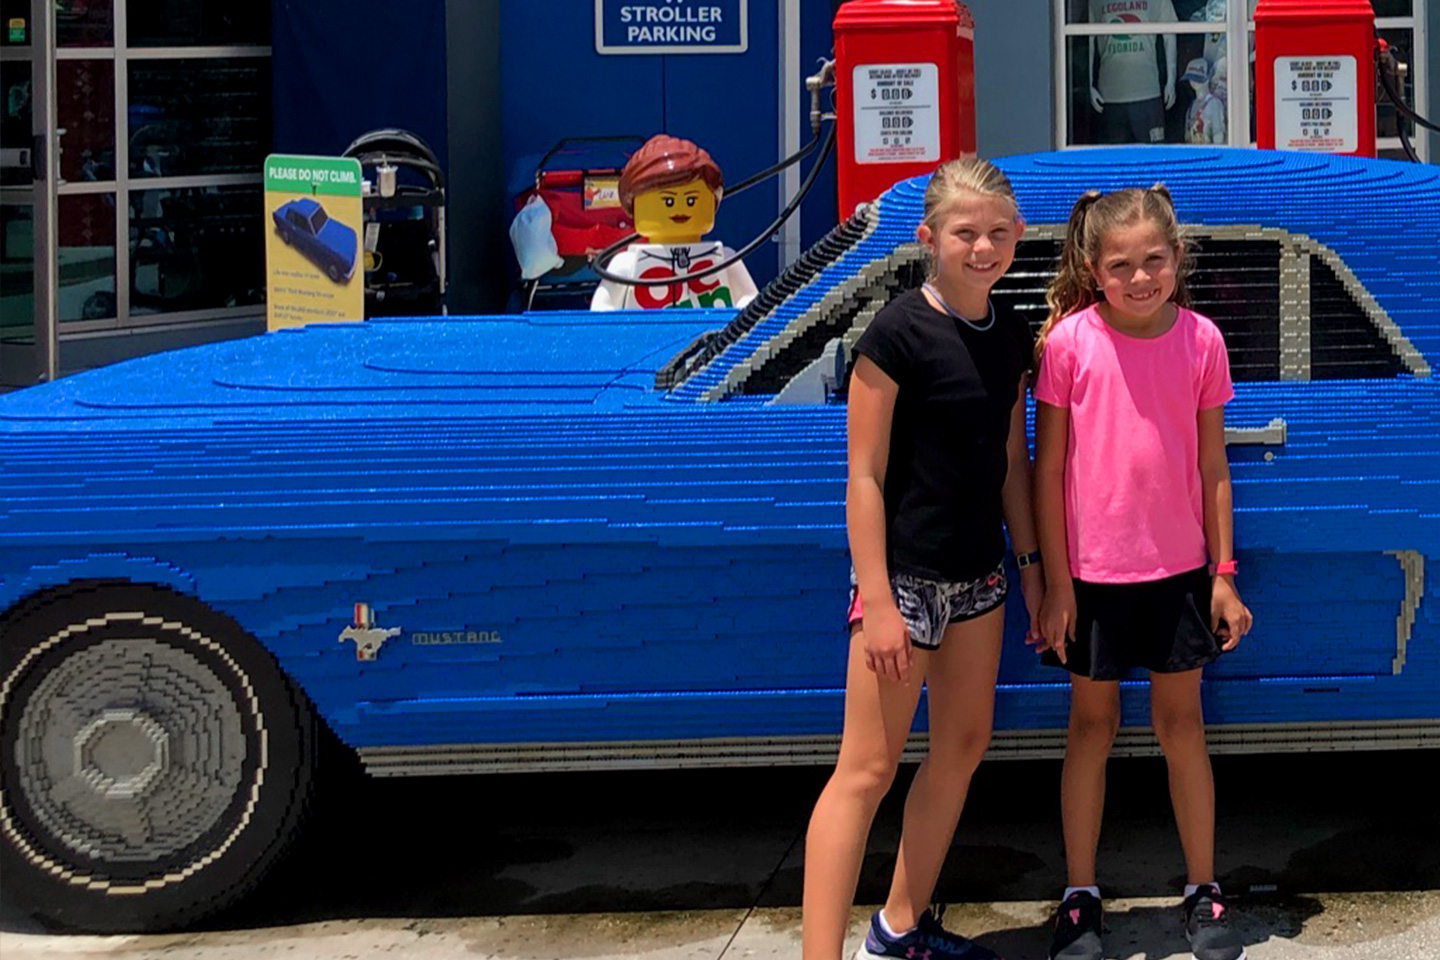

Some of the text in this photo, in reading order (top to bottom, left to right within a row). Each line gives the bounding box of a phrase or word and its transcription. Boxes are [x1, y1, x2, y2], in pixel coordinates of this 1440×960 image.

[619, 5, 723, 23] STROLLER
[1101, 0, 1148, 14] LEGOLAND
[627, 25, 716, 42] PARKING
[1108, 41, 1145, 54] FLORIDA
[269, 167, 297, 180] PLEASE
[298, 168, 311, 181] DO
[312, 169, 329, 182] NOT
[412, 631, 503, 645] MUSTANG
